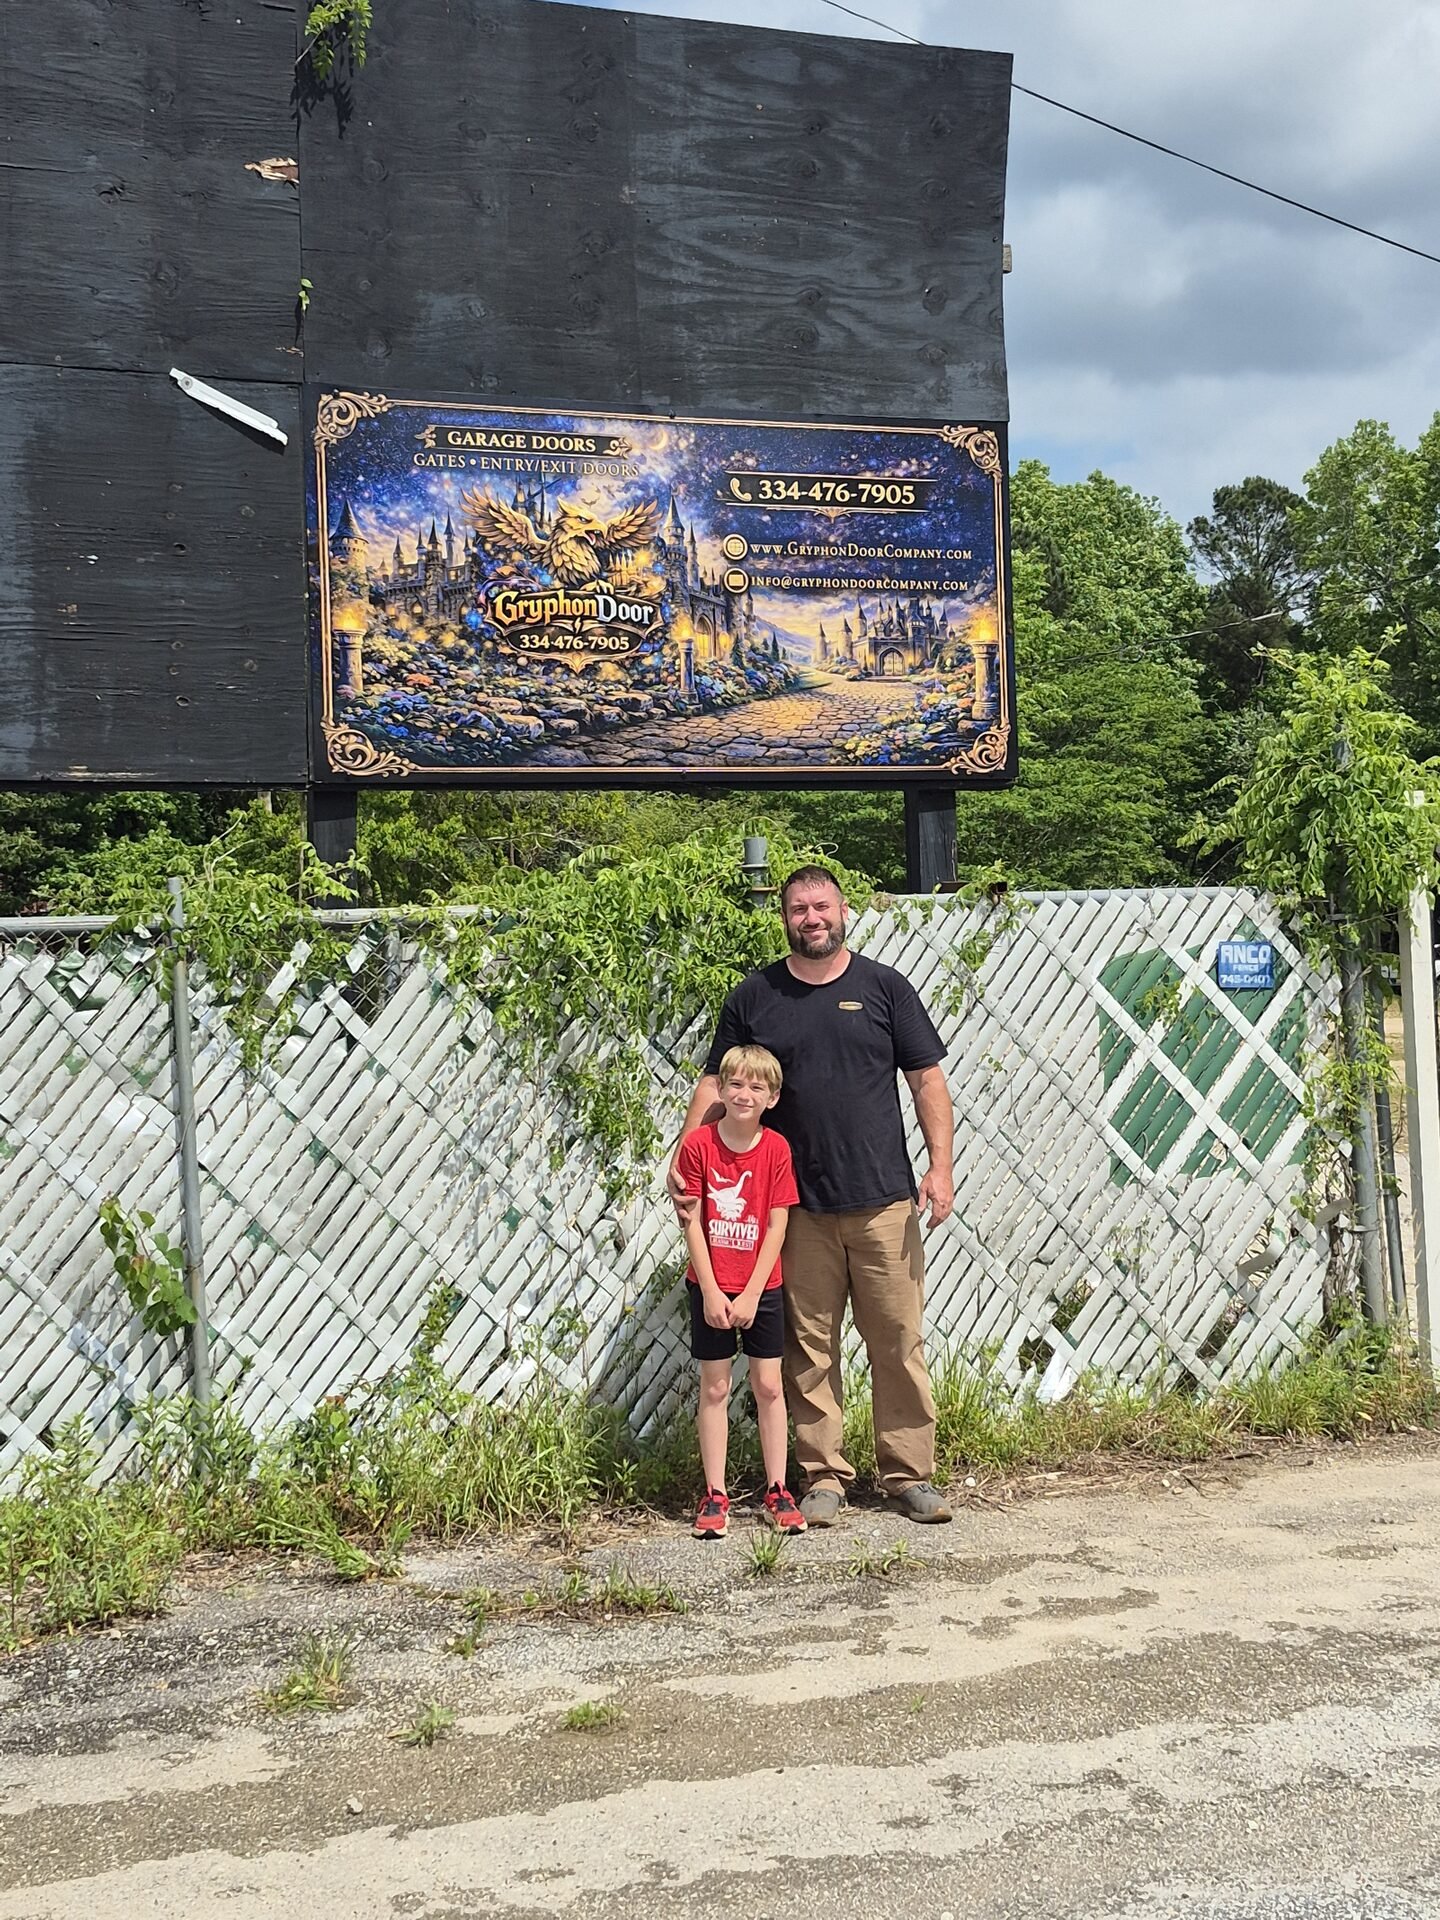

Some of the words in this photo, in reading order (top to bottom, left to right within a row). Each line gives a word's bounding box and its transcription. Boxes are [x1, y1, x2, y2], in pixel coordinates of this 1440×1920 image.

[447, 430, 527, 450] GARAGE
[532, 435, 597, 453] DOORS
[413, 452, 466, 469] GATES
[481, 456, 576, 475] ENTRY/EXIT
[582, 462, 640, 478] DOORS
[759, 480, 915, 505] 334-476-7905
[751, 575, 969, 592] INFO@GRYPHONDOORCOMPANY.COM
[495, 591, 653, 626] GryphonDoor
[519, 634, 630, 651] 334-476-7905
[1221, 945, 1271, 963] ANCO
[709, 1219, 759, 1240] SURVIVED
